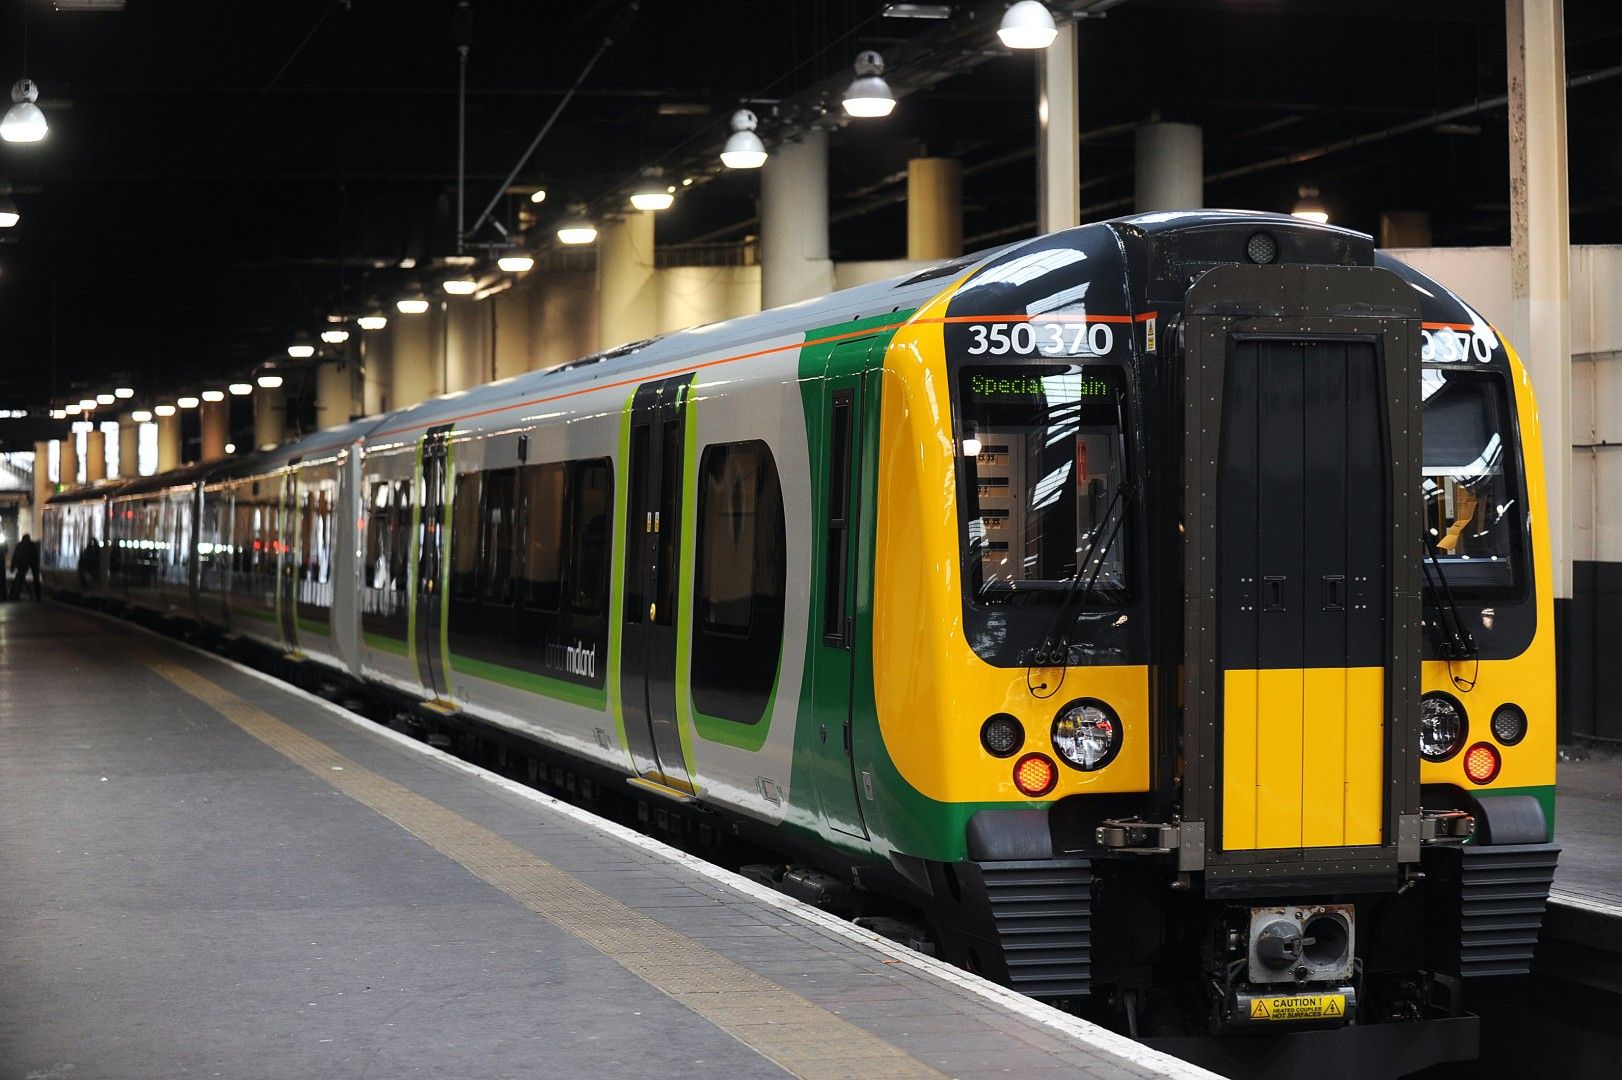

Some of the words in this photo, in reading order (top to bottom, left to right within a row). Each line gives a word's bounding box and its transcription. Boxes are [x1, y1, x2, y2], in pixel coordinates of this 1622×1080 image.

[968, 323, 1036, 355] 350
[1044, 323, 1113, 355] 370
[1273, 998, 1316, 1007] CAUTION
